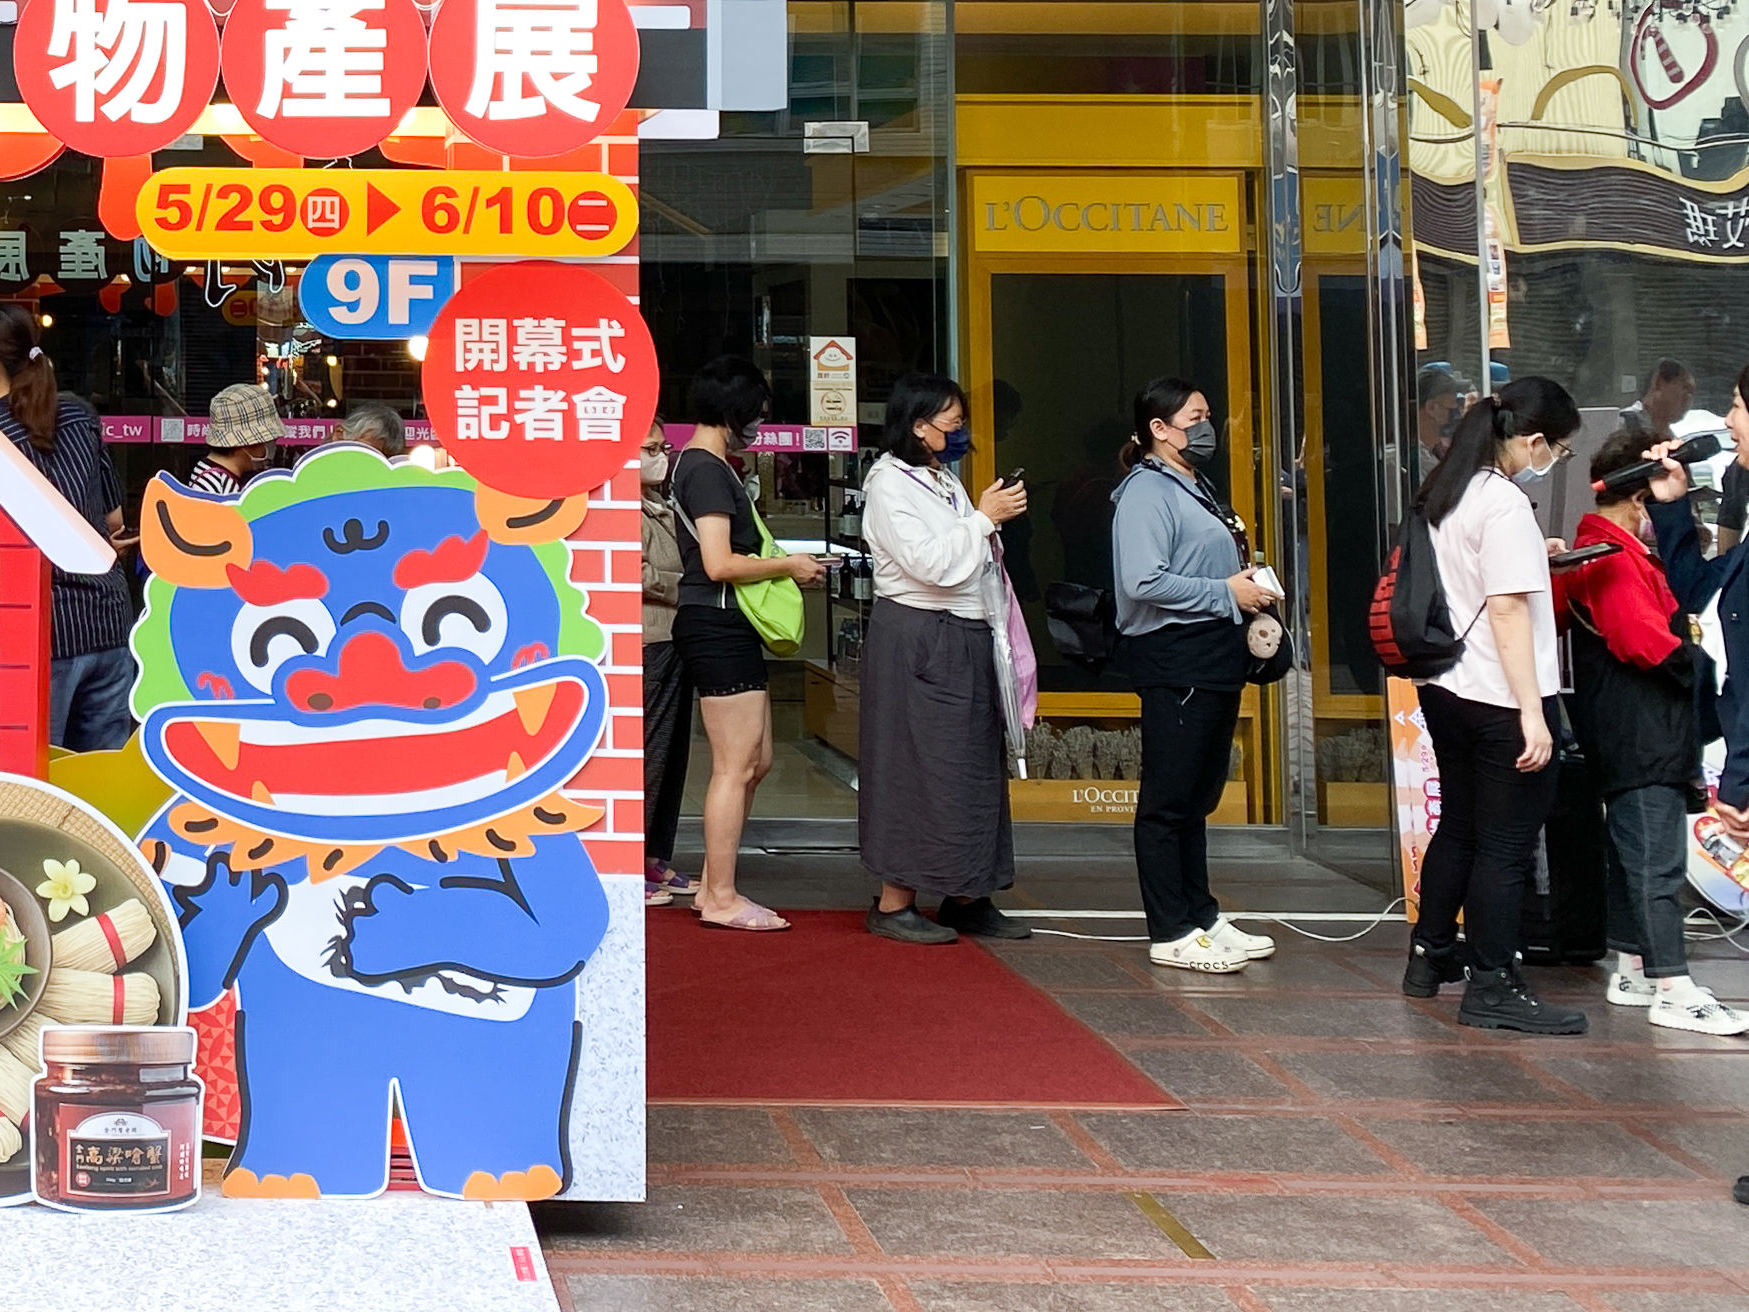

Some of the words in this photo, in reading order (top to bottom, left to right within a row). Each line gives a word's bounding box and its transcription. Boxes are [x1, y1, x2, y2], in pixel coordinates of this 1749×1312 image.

[326, 259, 439, 325] 9F
[453, 318, 627, 374] 開幕式
[453, 385, 629, 442] 記者會
